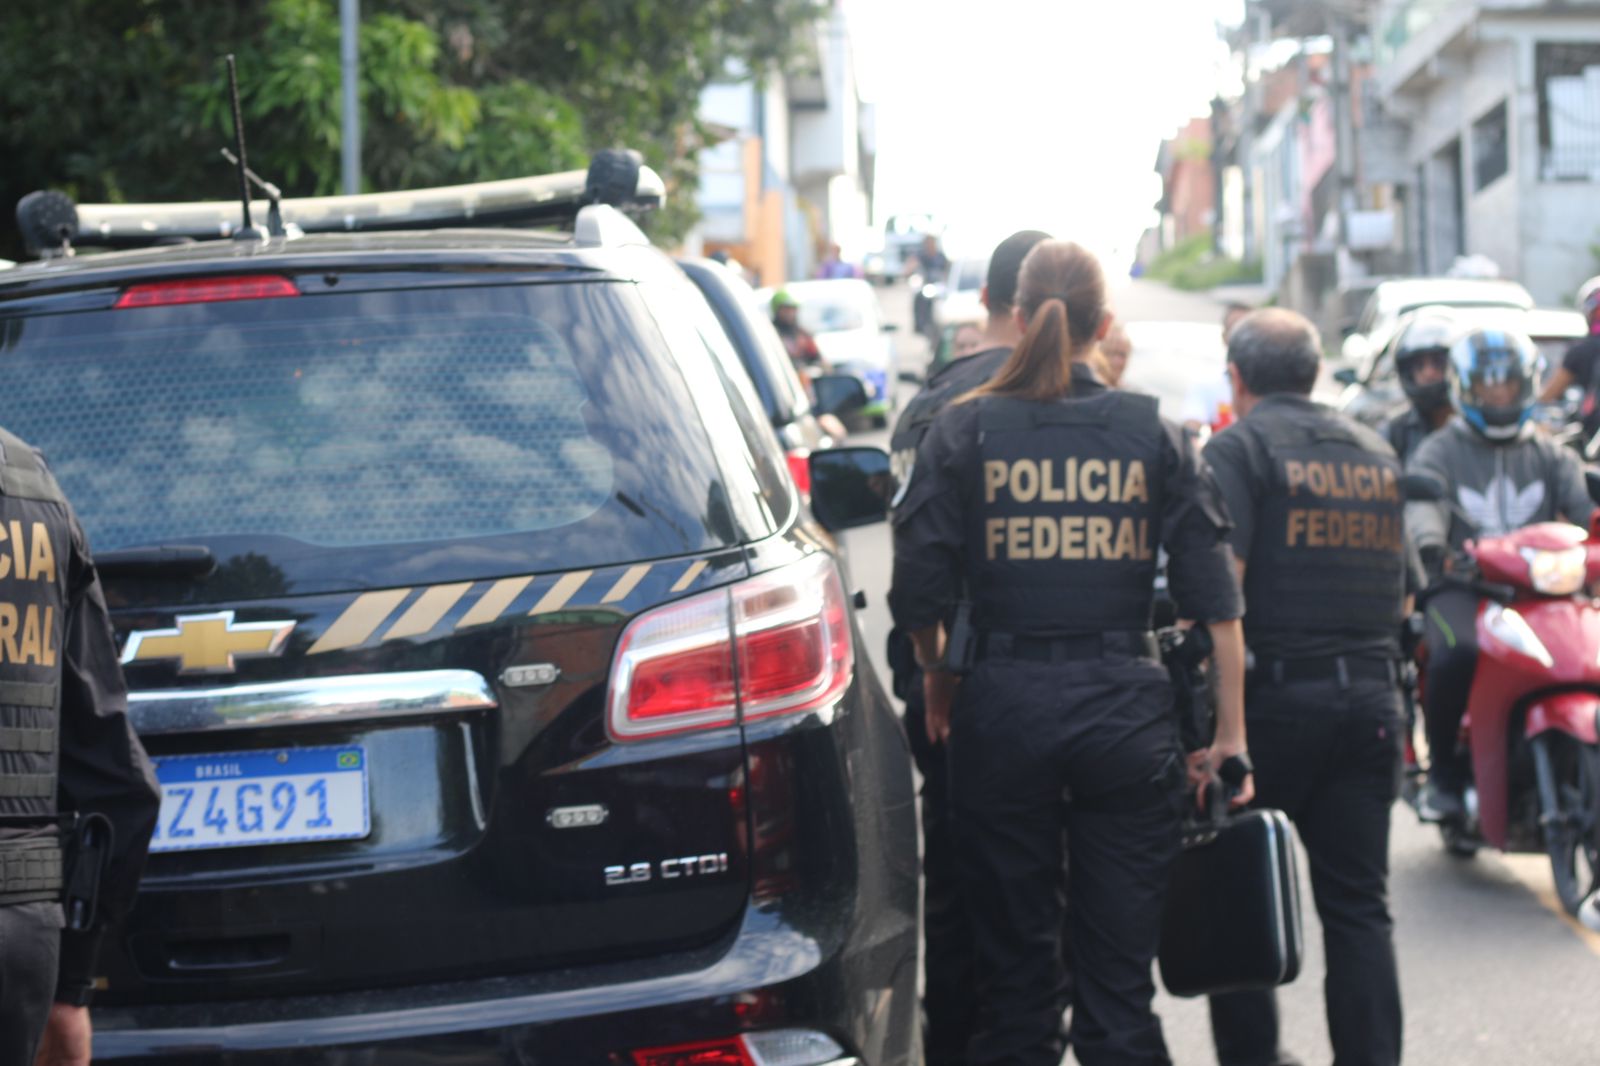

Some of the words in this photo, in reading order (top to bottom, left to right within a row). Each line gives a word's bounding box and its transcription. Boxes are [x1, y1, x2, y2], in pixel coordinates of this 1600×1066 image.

[985, 516, 1151, 561] FEDERAL
[1286, 509, 1404, 554] FEDERAL
[195, 763, 243, 779] BRASIL
[153, 778, 334, 840] Z4G91
[660, 852, 728, 878] CTDI
